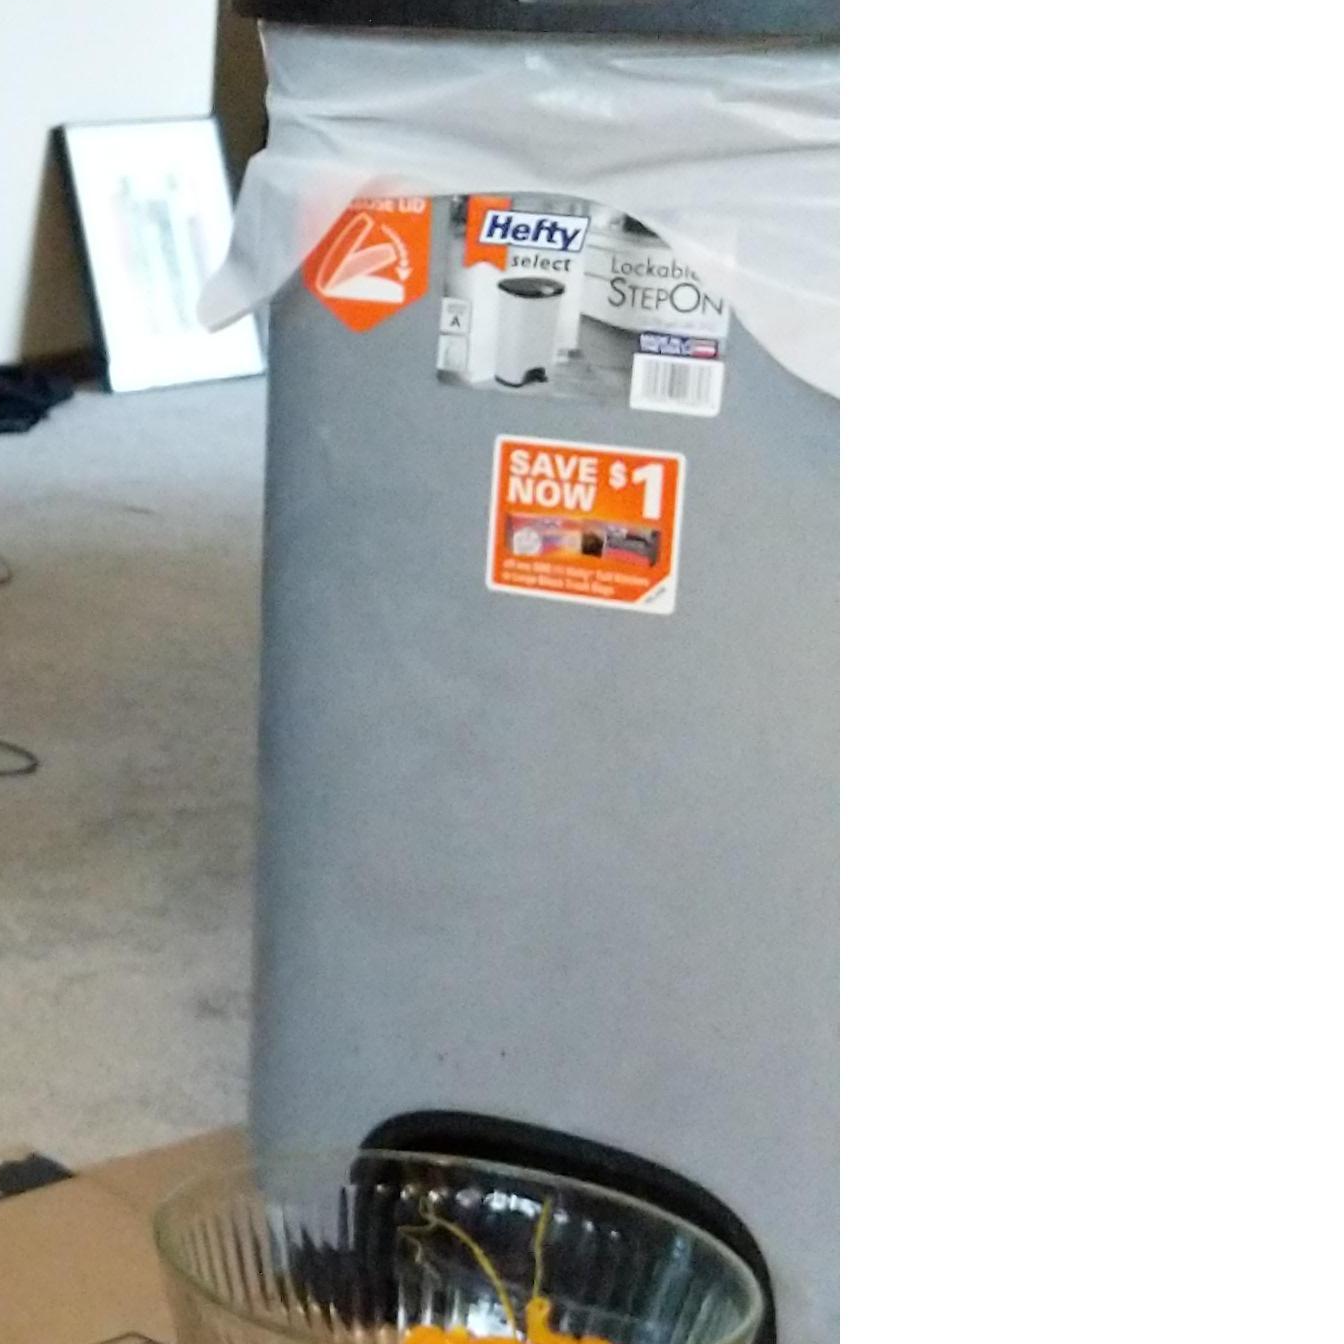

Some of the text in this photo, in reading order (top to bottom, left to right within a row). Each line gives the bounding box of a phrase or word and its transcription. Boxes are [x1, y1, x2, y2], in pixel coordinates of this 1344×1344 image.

[485, 214, 582, 250] Hefty
[511, 253, 572, 273] select
[509, 449, 599, 484] SAVE
[506, 476, 598, 512] NOW
[608, 460, 665, 520] $1
